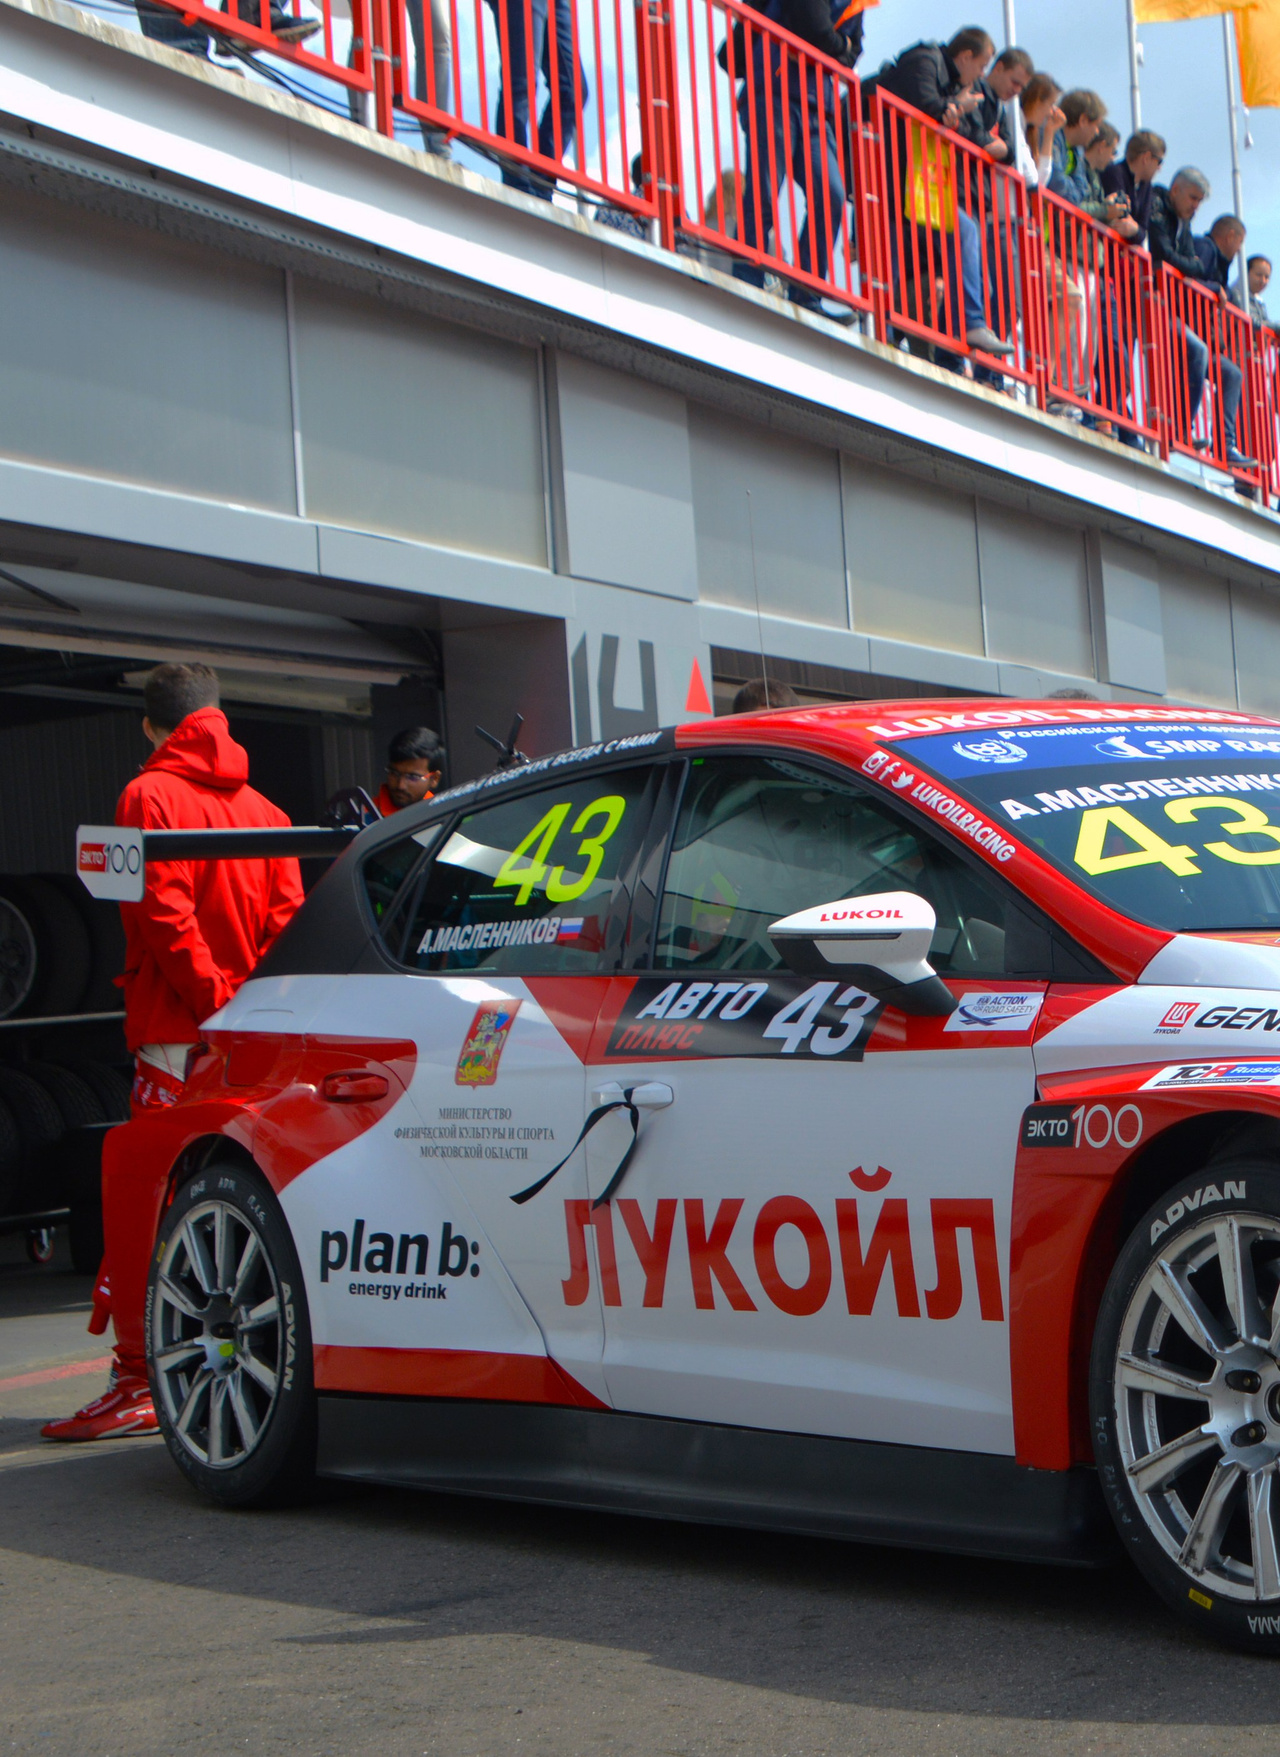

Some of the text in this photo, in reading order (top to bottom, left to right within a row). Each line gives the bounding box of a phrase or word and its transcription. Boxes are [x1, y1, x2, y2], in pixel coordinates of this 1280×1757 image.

[571, 630, 660, 748] 14
[866, 709, 1069, 737] LUKOIL
[1067, 707, 1250, 723] RACING
[997, 723, 1130, 739] Российская
[1134, 725, 1195, 735] серия
[604, 739, 618, 753] С
[615, 731, 662, 751] НАМИ
[1145, 740, 1220, 753] SMP
[911, 782, 1016, 862] LUKOILRACING
[103, 843, 140, 874] 100
[493, 795, 626, 906] 43
[820, 910, 903, 922] LUKOIL
[417, 917, 562, 954] А.МАСЛЕННИКОВ
[635, 982, 769, 1020] АВТО
[989, 996, 1028, 1005] ACTION
[1004, 1005, 1035, 1013] SAFETY
[762, 981, 880, 1055] 43
[614, 1025, 703, 1050] ПЛЮС
[1169, 1065, 1237, 1080] TCR
[438, 1107, 512, 1120] МИНИСТЕРСТВО
[1027, 1104, 1143, 1149] ЭКТО 100
[394, 1124, 555, 1140] ФИЗИЧЕСКОЙ КУЛЬТУРЫ И СПОРТА
[419, 1144, 529, 1159] МОСКОВСКОЙ ОБЛАСТИ
[1151, 1181, 1246, 1246] ADVAN
[320, 1219, 480, 1282] plan b:
[561, 1165, 1004, 1322] ЛУКОЙЛ
[349, 1282, 447, 1300] energy drink
[280, 1282, 296, 1390] ADVAN
